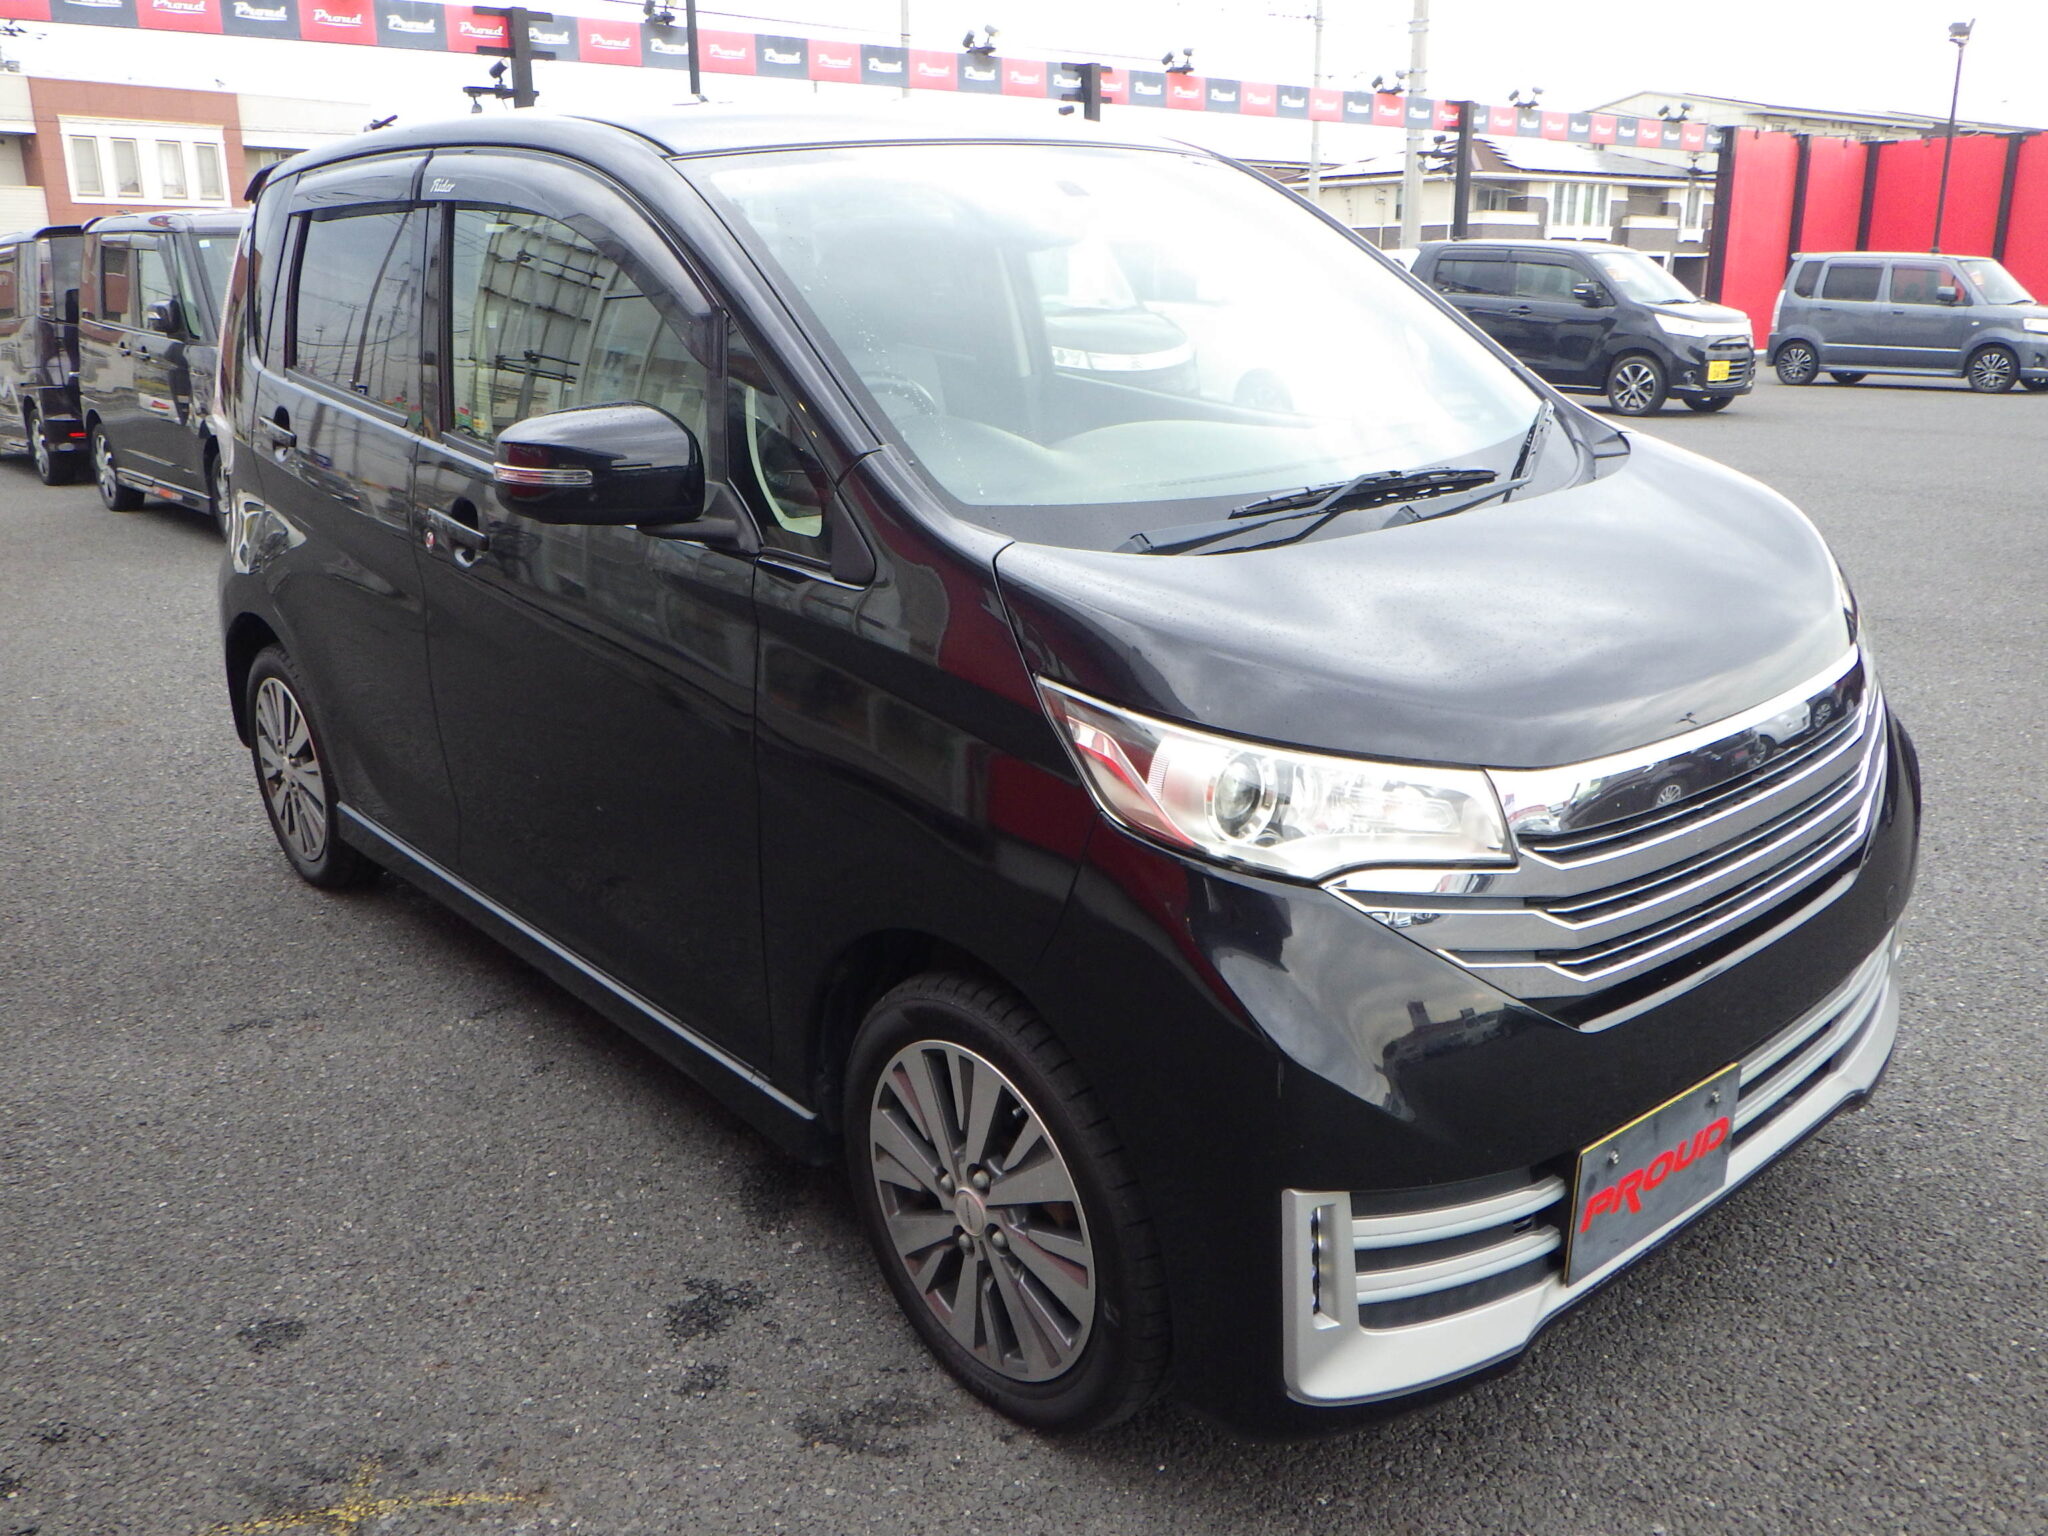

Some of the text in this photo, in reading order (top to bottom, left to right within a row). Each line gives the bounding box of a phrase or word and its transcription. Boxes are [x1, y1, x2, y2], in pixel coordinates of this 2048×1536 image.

[232, 2, 288, 20] Proud
[313, 9, 363, 26] Proud
[386, 15, 436, 33] Proud
[459, 22, 504, 38] Proud
[590, 33, 631, 49] Proud
[709, 44, 746, 59] Proud
[1579, 1116, 1731, 1233] PROUD
